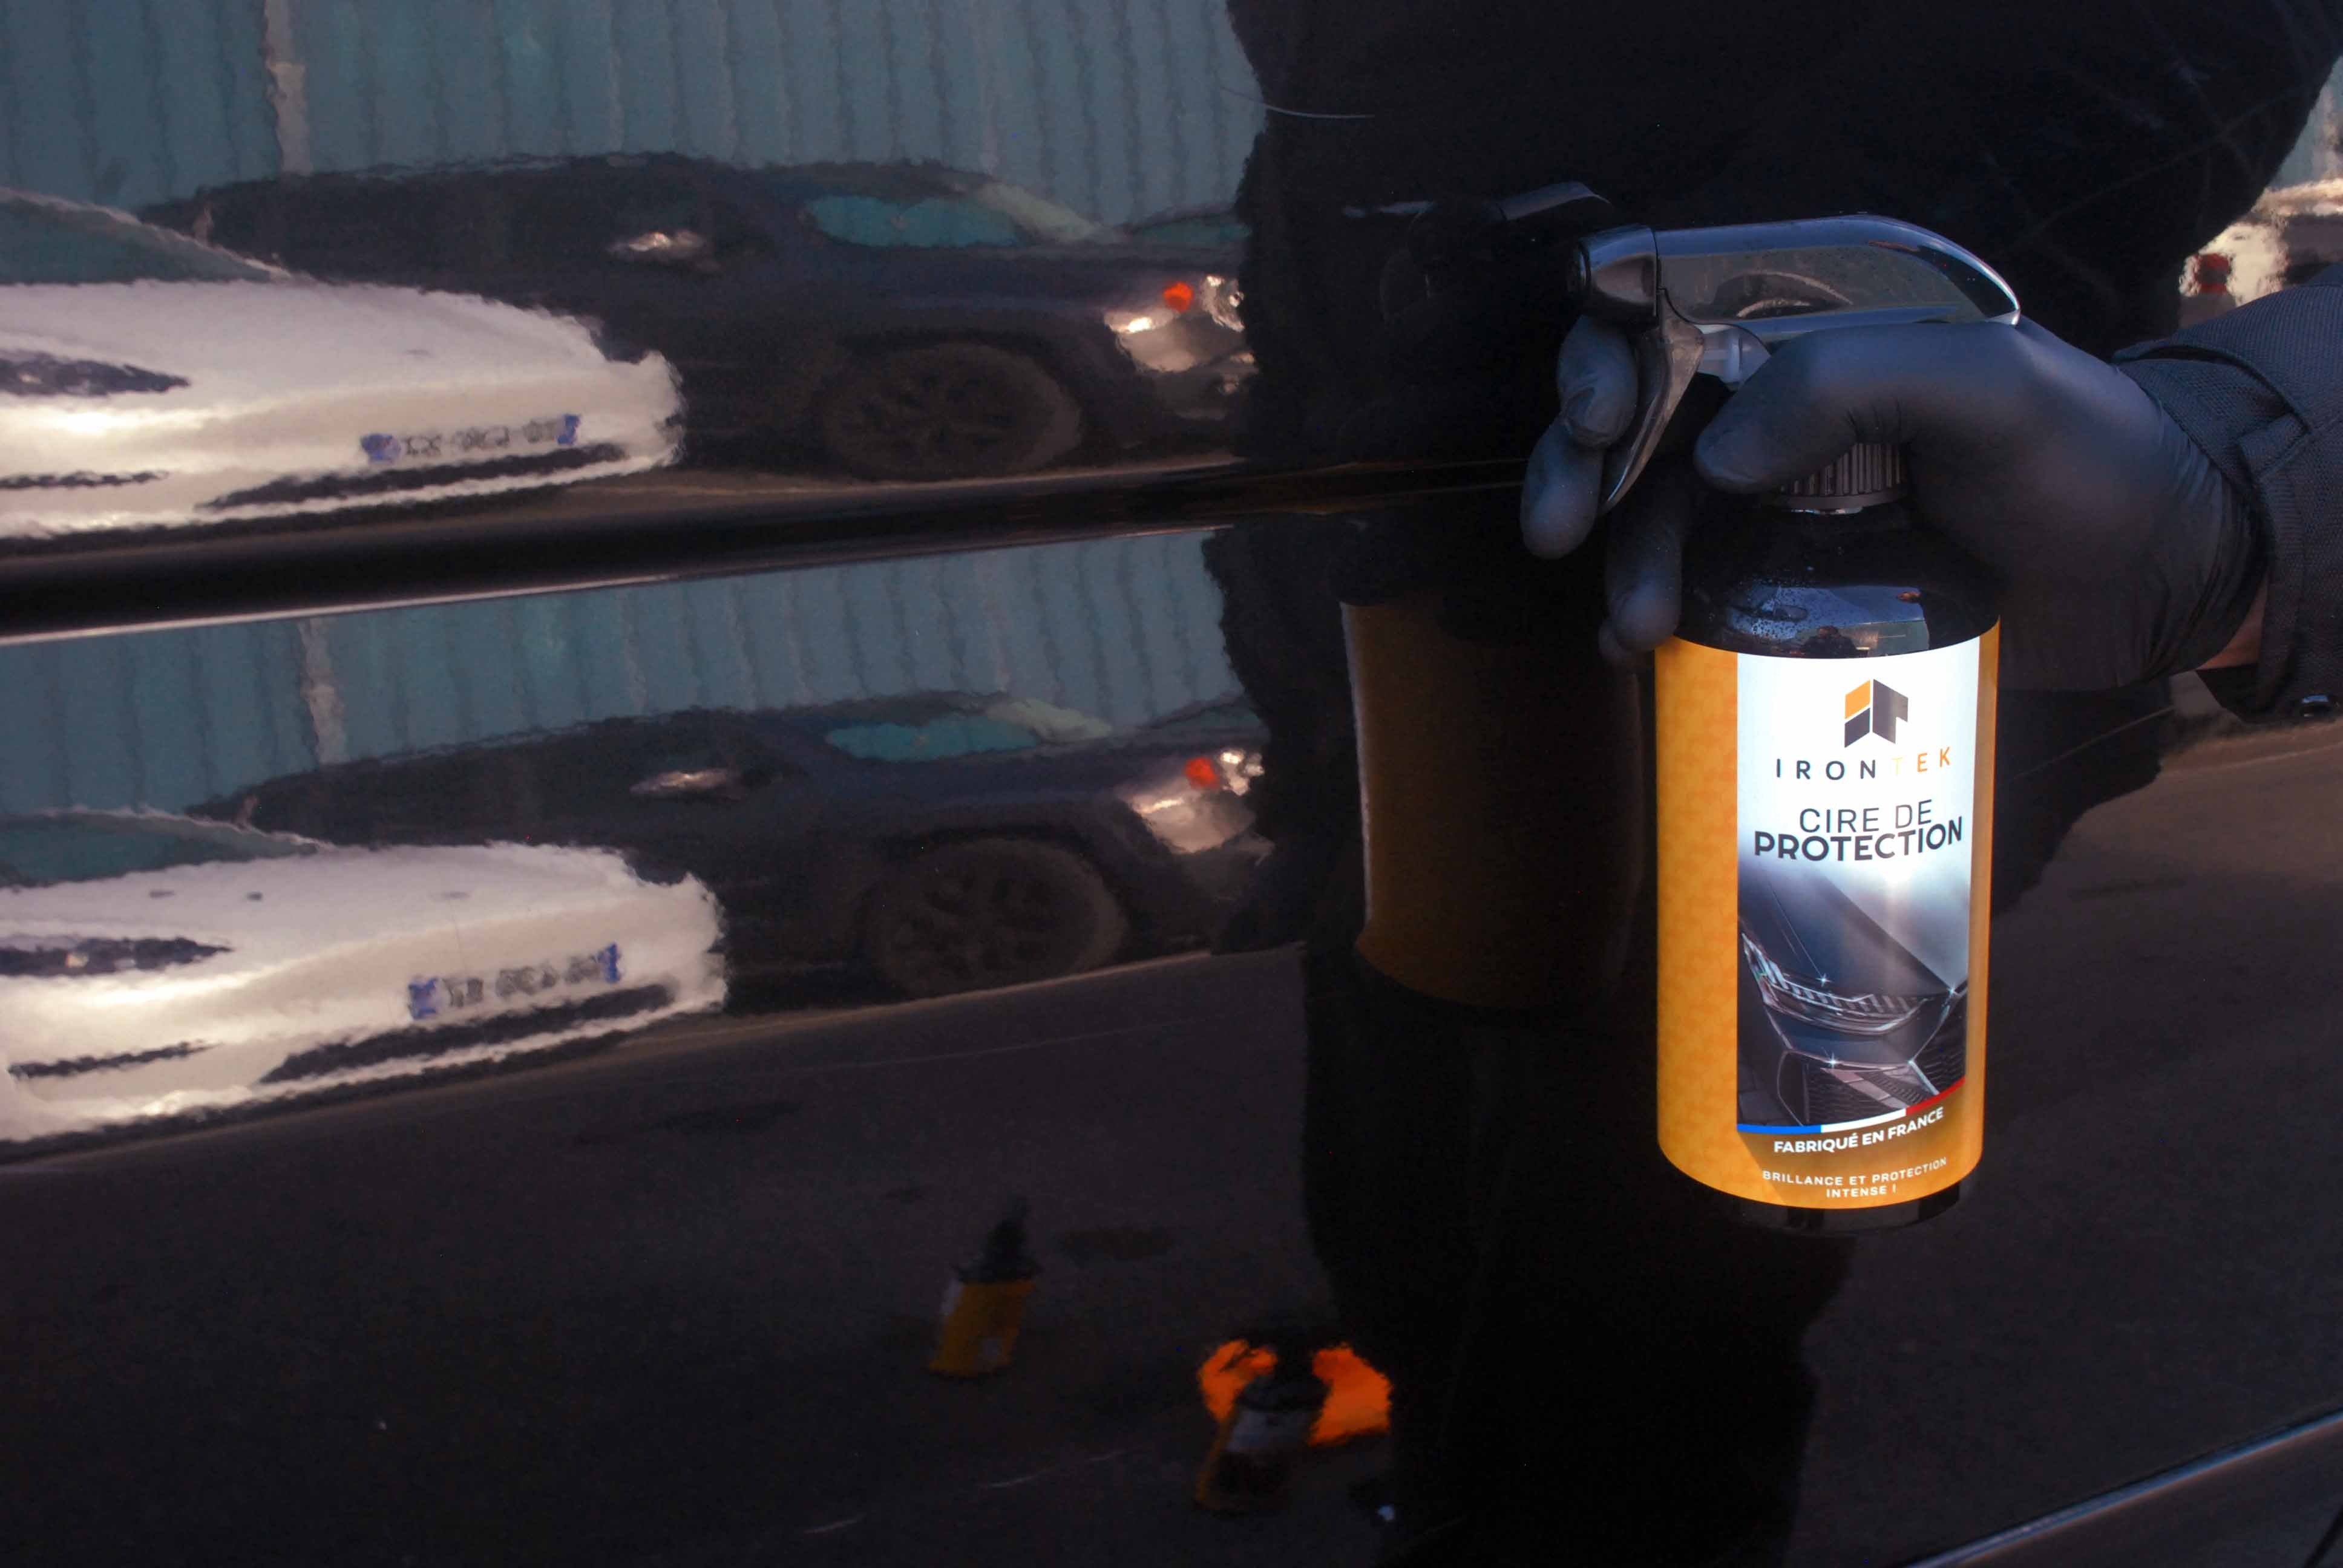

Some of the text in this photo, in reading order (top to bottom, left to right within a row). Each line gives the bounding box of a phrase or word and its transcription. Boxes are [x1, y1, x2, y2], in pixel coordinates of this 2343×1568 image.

[1776, 746, 1951, 780] IRONTEK
[1800, 799, 1932, 833] CIRE DE
[1755, 816, 1962, 861] PROTECTION
[1774, 1106, 1944, 1153] FABRIQUÉ EN FRANCE
[1762, 1157, 1947, 1186] BRILLANCE ET PROTECTION
[1826, 1186, 1887, 1198] INTENSE
